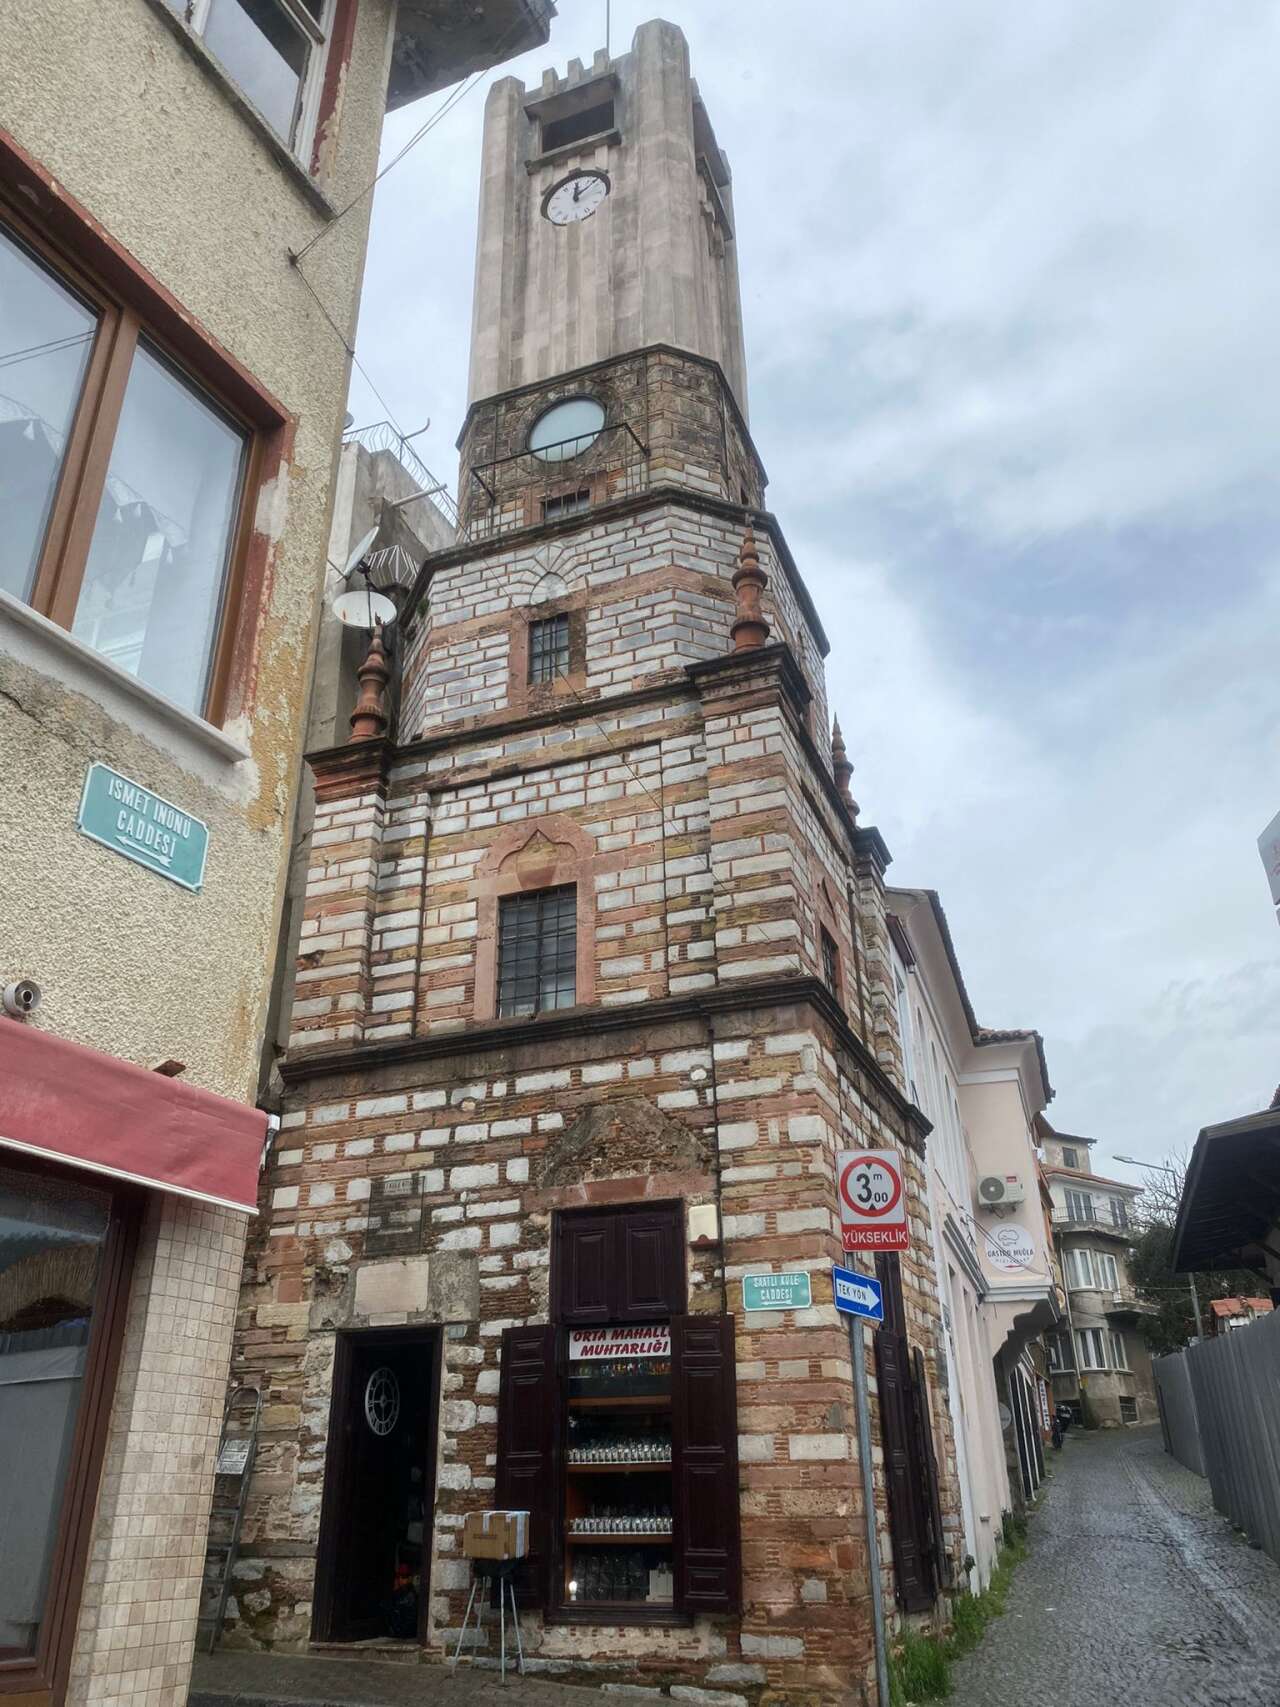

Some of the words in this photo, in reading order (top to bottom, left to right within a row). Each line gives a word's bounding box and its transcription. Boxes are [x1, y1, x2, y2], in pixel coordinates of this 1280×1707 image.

[856, 1173, 872, 1203] 3
[874, 1192, 889, 1203] 00
[842, 1229, 908, 1244] YÜKSEKLİK
[838, 1283, 852, 1296] TEK
[573, 1330, 607, 1342] ORTA
[580, 1339, 669, 1356] MUHTARLIĞI
